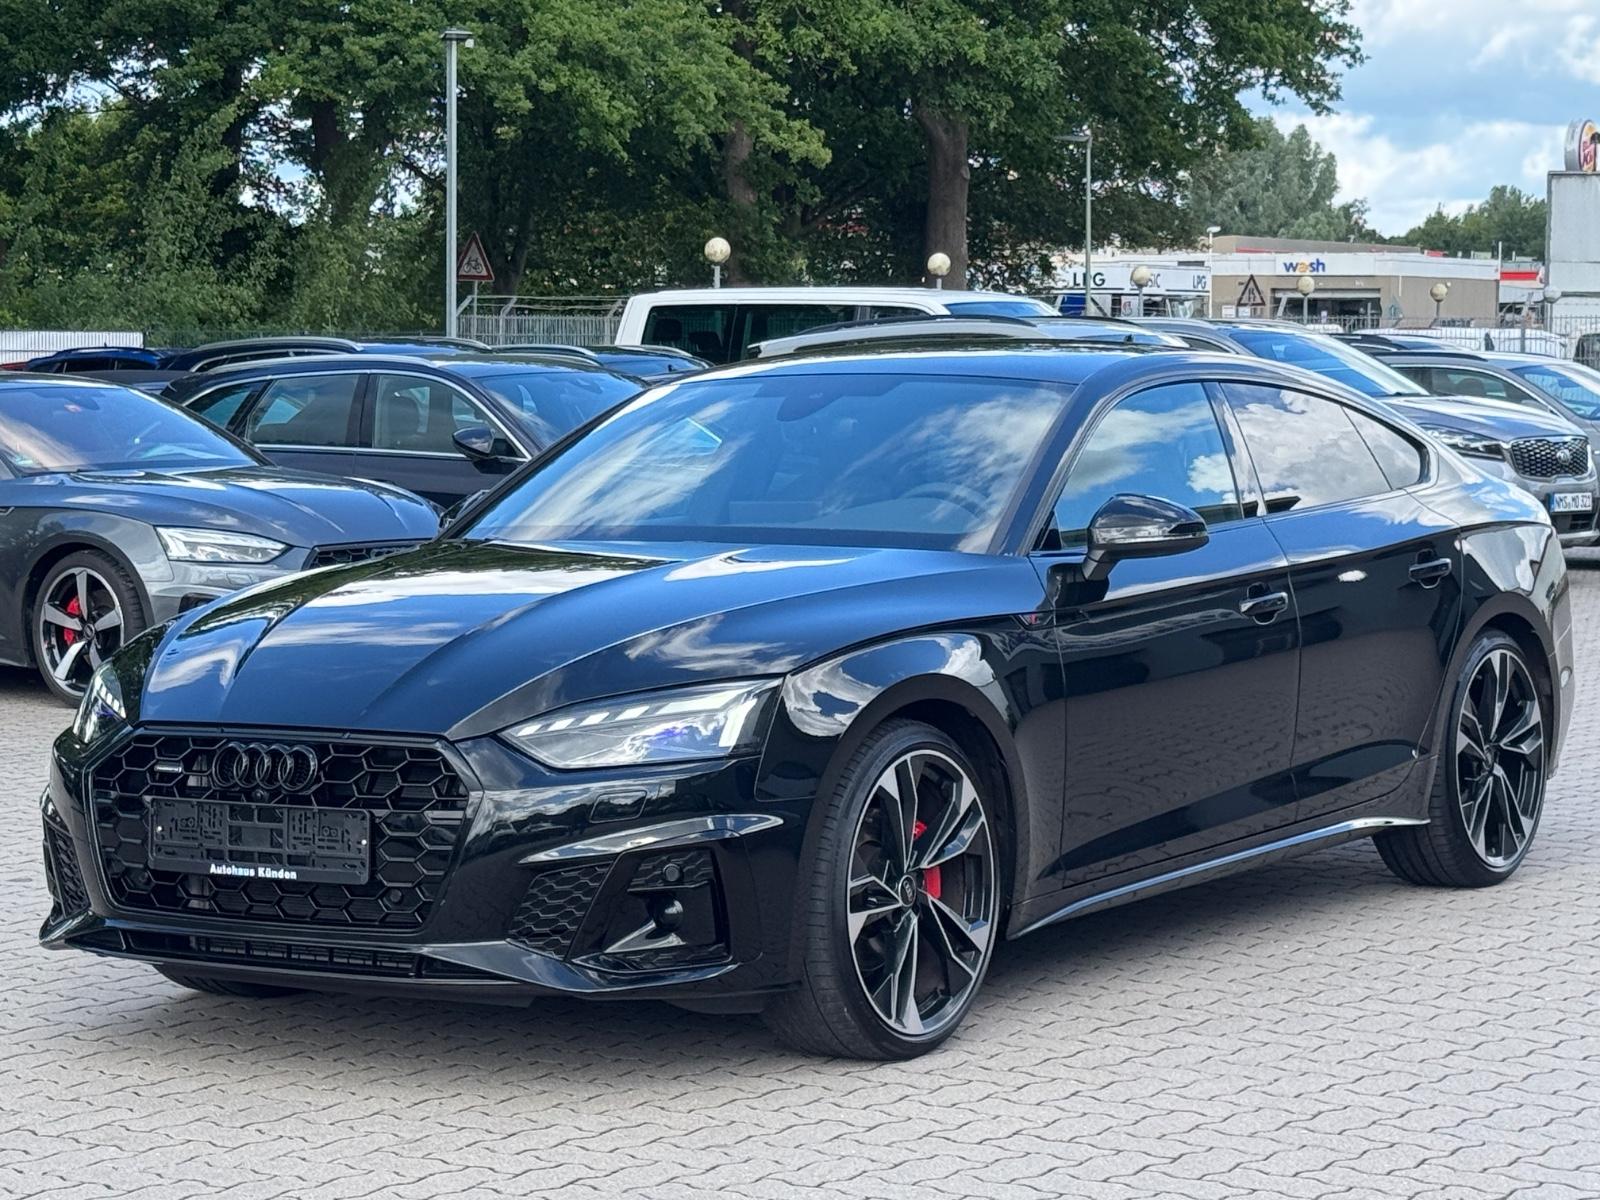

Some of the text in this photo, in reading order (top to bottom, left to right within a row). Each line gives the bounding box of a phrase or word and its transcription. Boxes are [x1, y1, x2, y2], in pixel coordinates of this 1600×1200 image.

[1283, 258, 1326, 273] wash
[1192, 274, 1207, 290] LPG
[210, 863, 297, 880] Autohaus Künden
